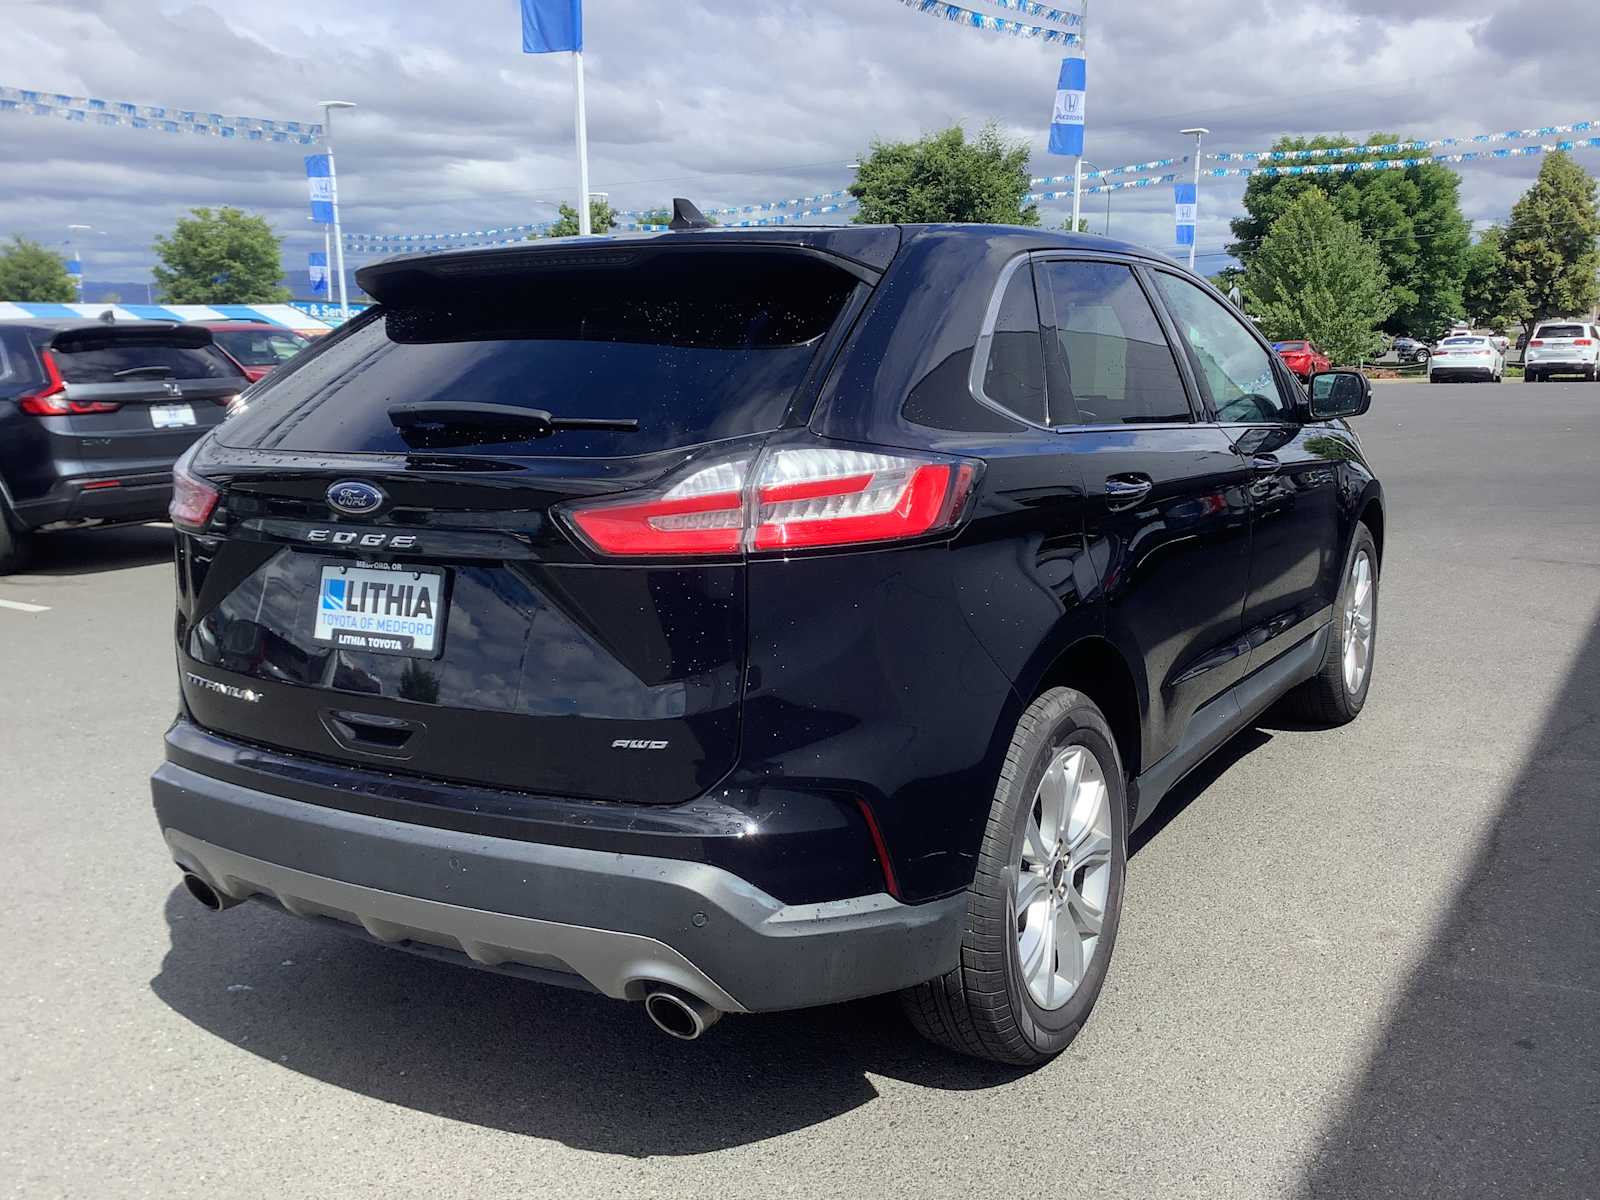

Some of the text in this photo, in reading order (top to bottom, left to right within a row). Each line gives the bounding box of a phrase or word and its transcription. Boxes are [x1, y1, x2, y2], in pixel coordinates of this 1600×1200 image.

[338, 488, 368, 507] Ford
[307, 529, 417, 548] EDGE
[392, 563, 402, 571] OR
[346, 580, 433, 620] LITHIA
[322, 613, 433, 636] TOYOTA OF MEDFORD
[338, 635, 402, 649] LITHIA TOYOTA
[611, 739, 669, 749] AWD
